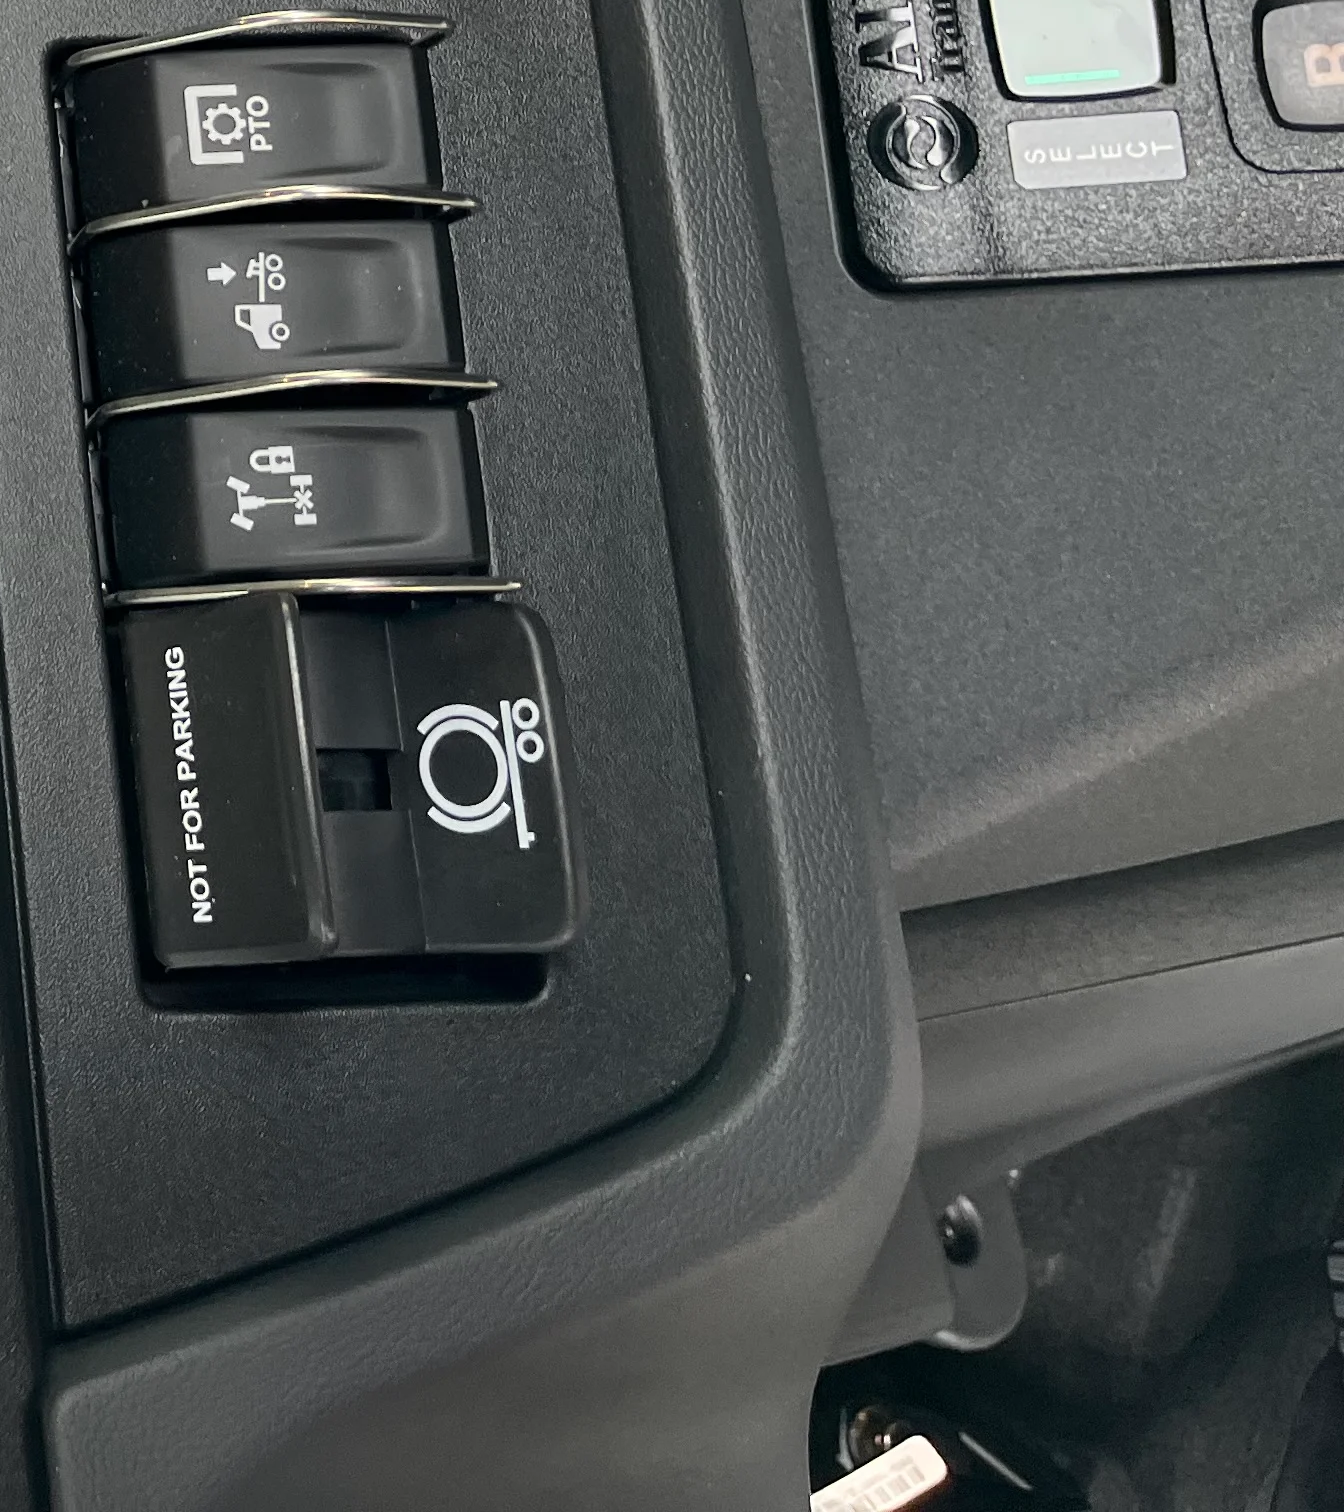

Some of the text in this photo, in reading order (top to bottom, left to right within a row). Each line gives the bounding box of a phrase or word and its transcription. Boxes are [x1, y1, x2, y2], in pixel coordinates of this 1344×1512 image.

[246, 94, 273, 153] PTO
[1024, 138, 1176, 164] SELECT
[164, 645, 213, 925] NOT FOR PARKING
